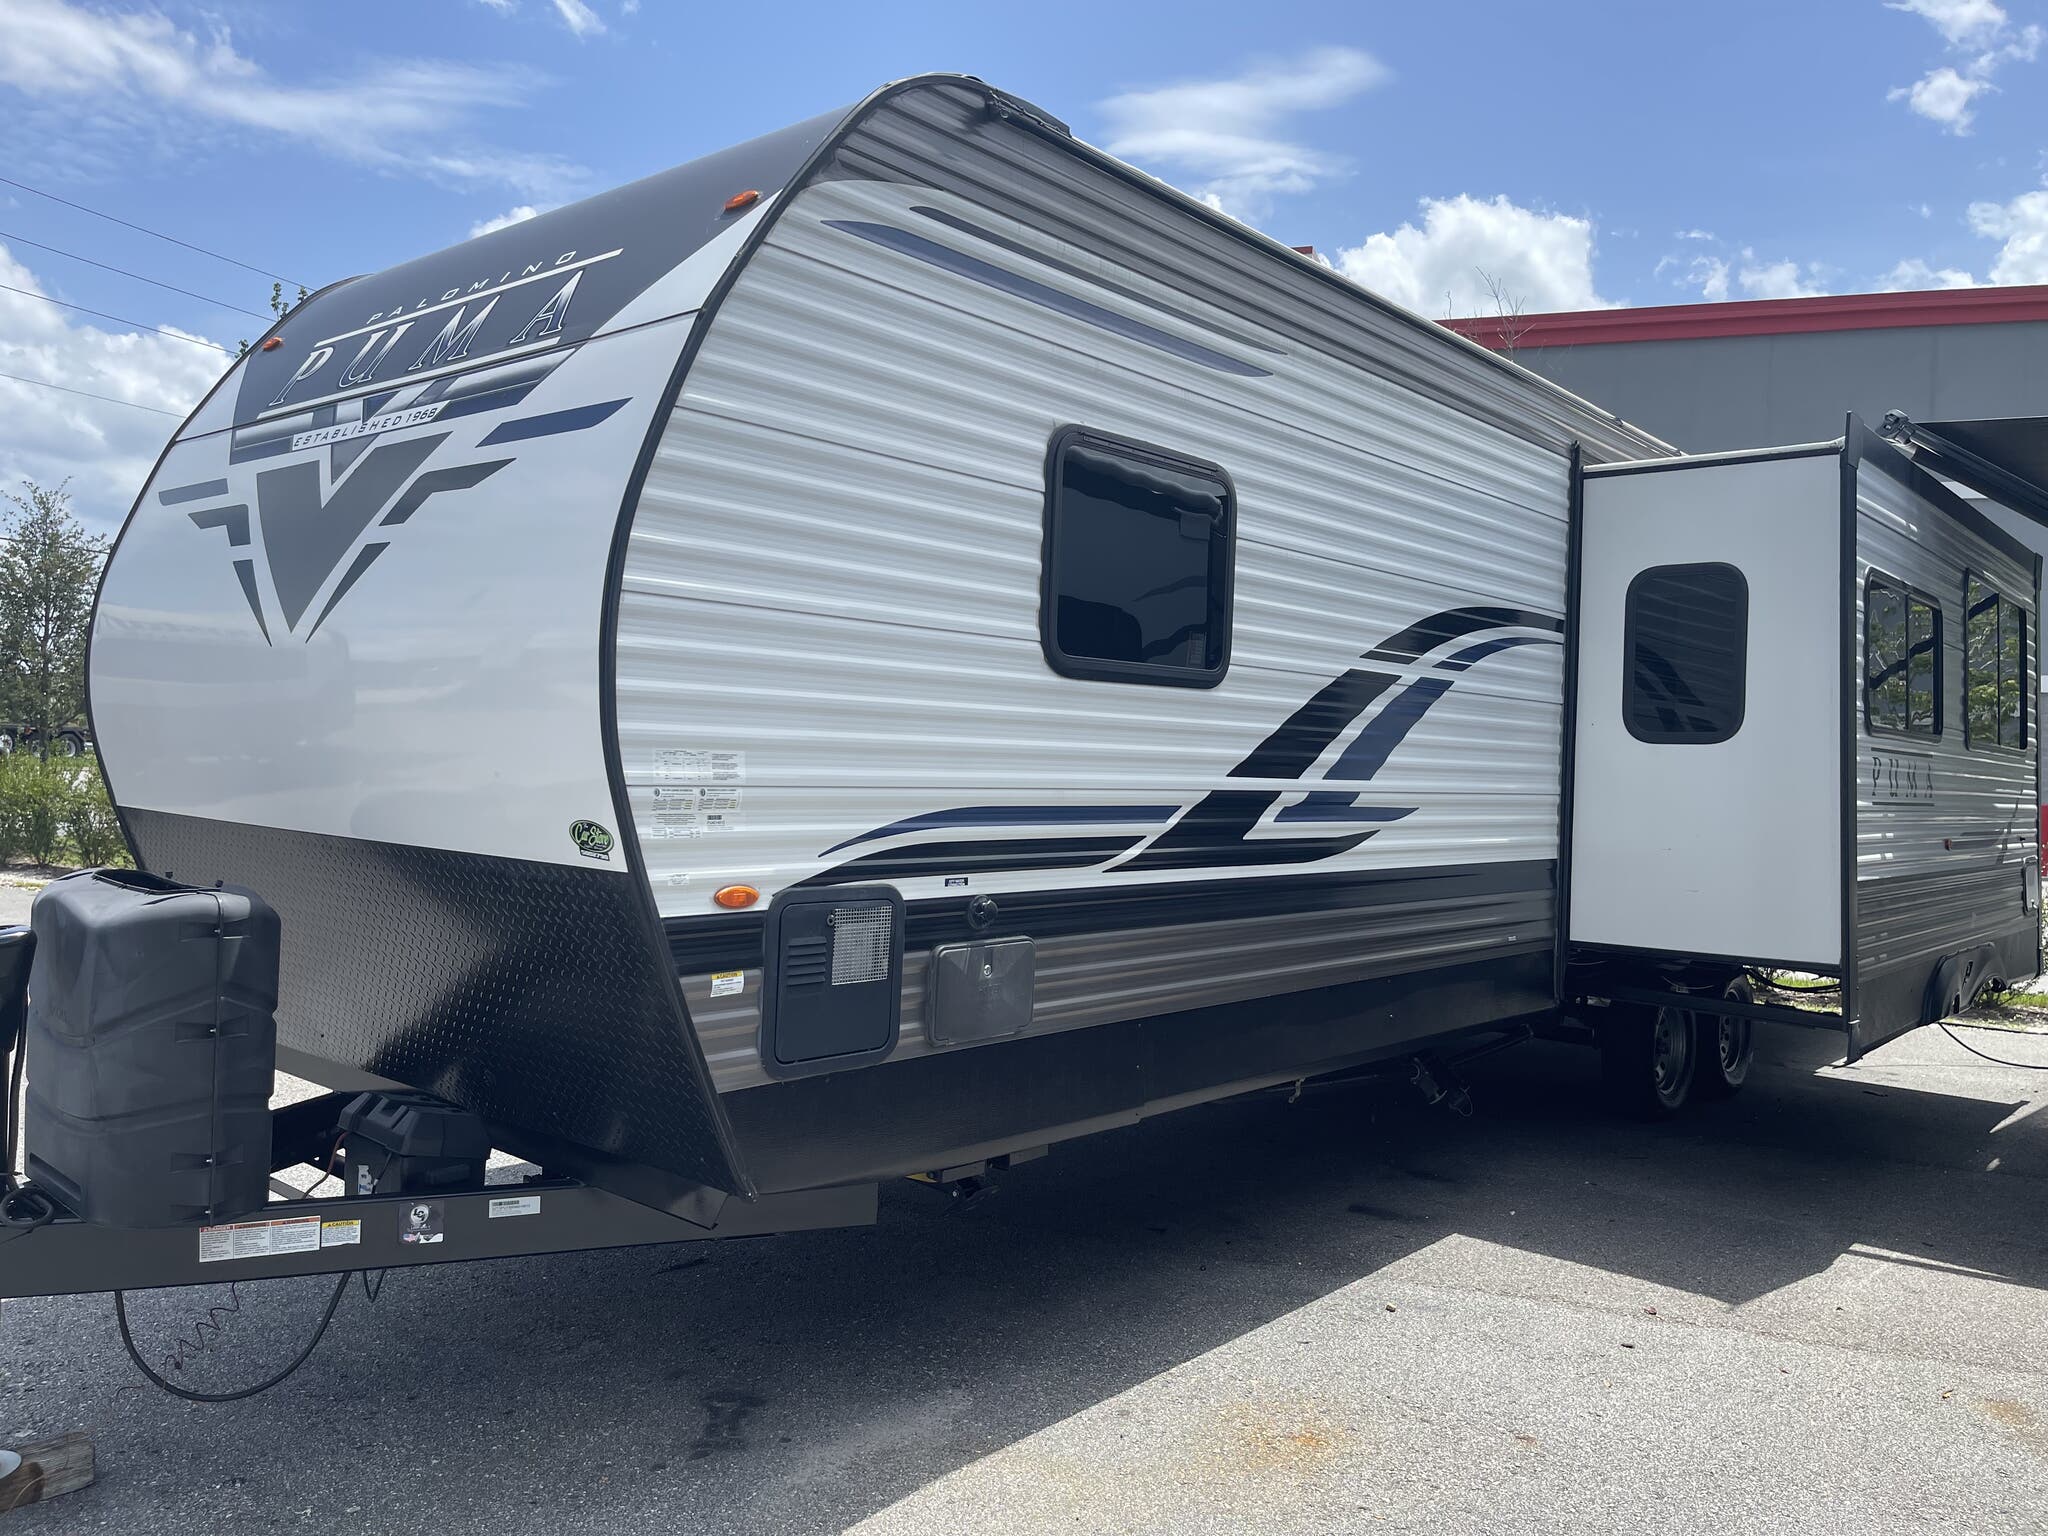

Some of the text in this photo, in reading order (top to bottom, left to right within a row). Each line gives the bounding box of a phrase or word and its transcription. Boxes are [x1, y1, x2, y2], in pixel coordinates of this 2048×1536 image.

[366, 250, 578, 325] PALOMINO
[268, 268, 585, 407] PUMA
[293, 406, 439, 448] ESTABLISHED 1968
[1871, 756, 1934, 799] PUMA
